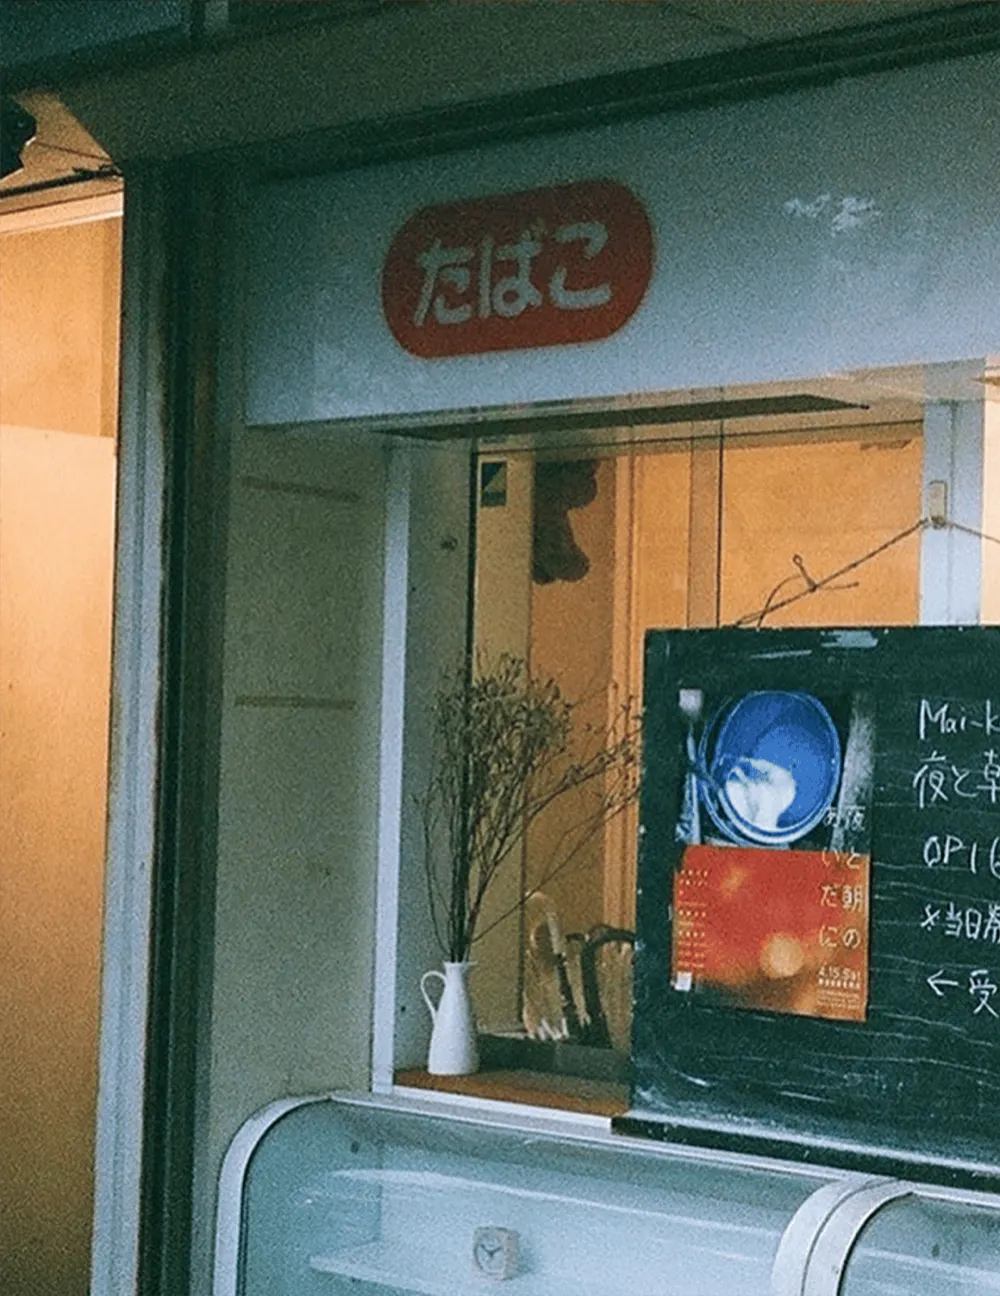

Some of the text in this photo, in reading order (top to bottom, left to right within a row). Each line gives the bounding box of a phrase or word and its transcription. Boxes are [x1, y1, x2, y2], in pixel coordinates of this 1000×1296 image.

[414, 219, 613, 327] たばこ
[842, 805, 866, 949] 夜と朝の
